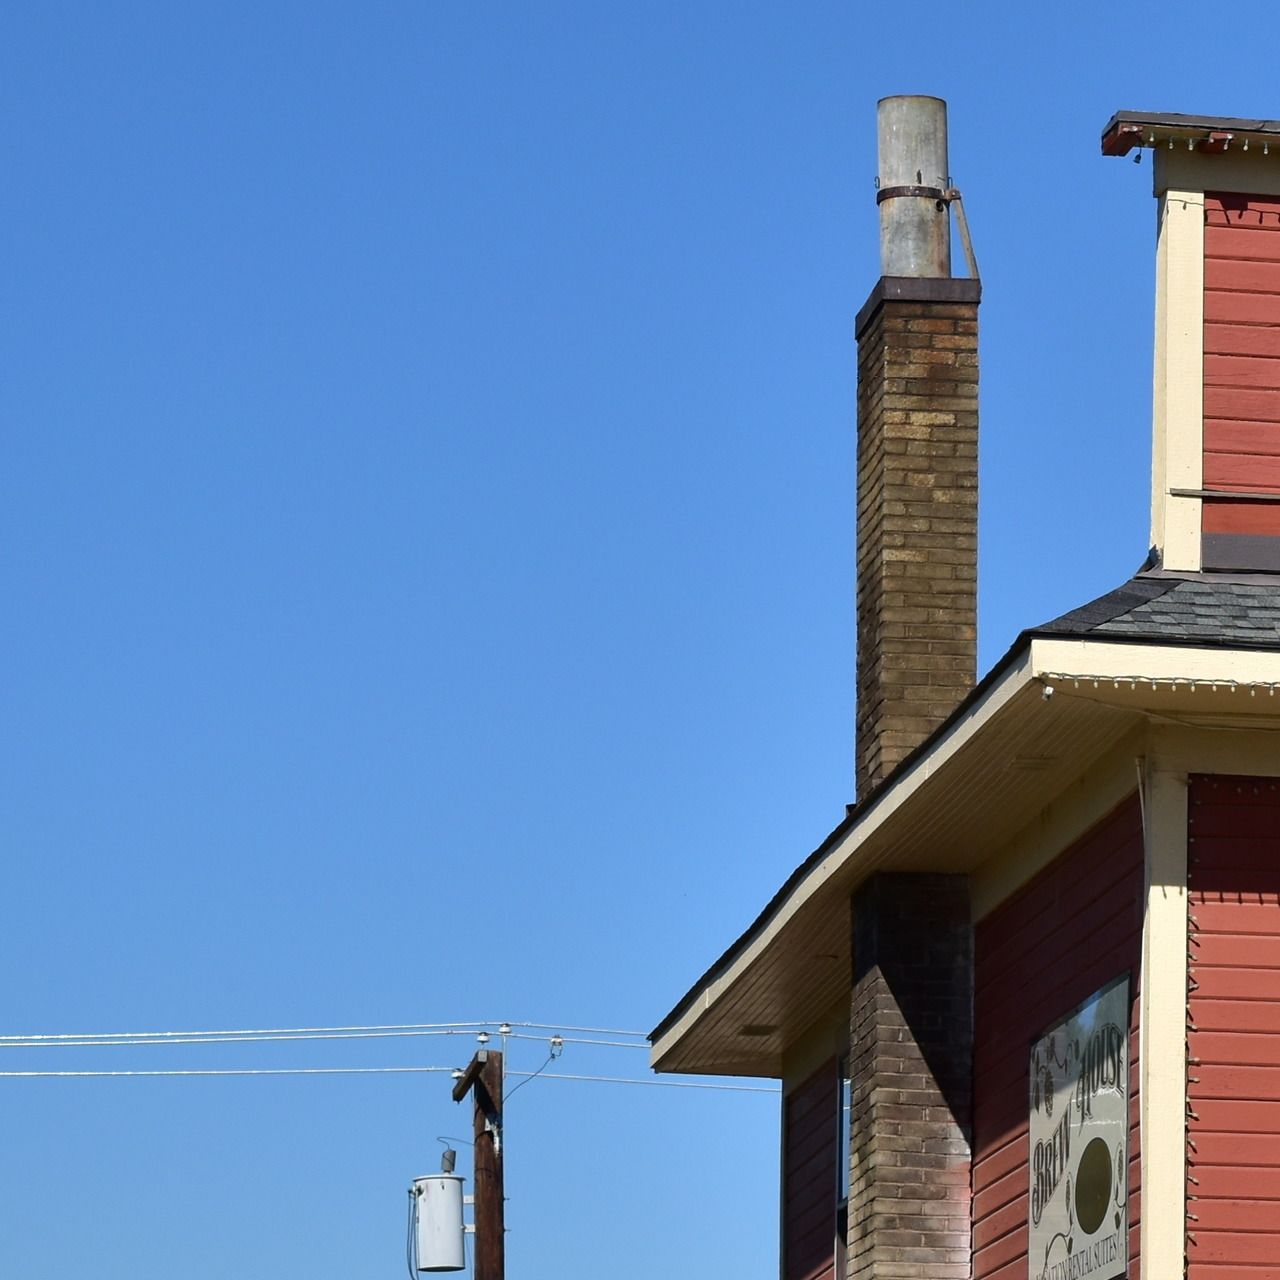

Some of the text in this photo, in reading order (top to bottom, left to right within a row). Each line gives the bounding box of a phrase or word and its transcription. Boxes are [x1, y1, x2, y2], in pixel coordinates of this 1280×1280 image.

[1032, 1022, 1124, 1228] BREW HOUSE
[1094, 1233, 1117, 1271] SUITES
